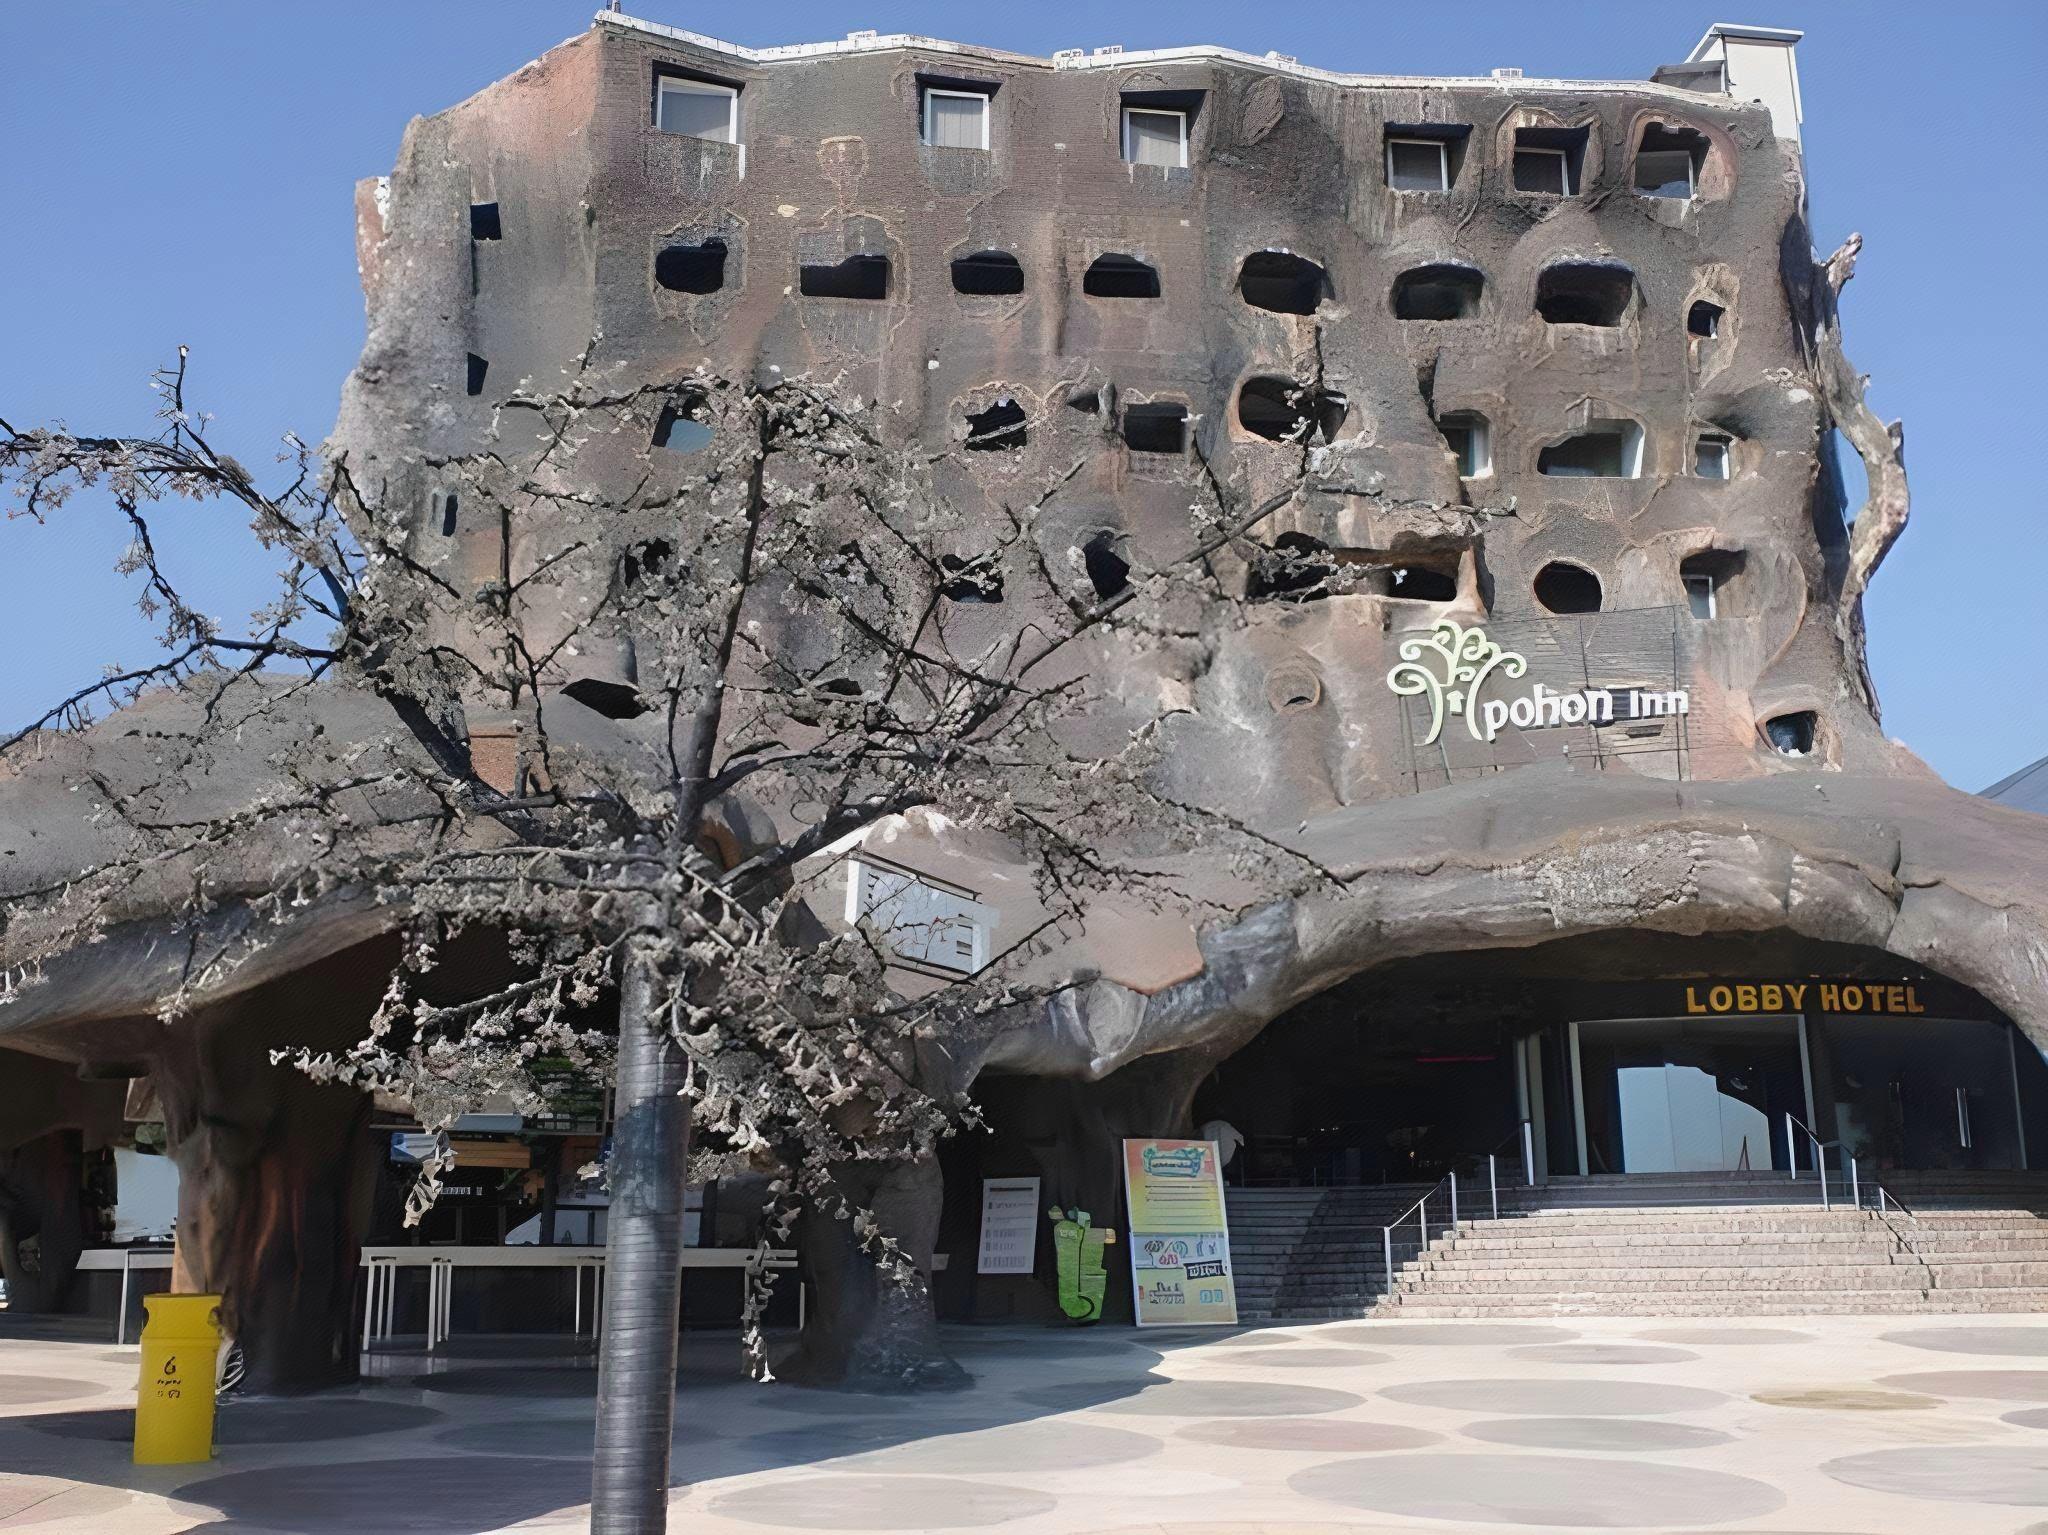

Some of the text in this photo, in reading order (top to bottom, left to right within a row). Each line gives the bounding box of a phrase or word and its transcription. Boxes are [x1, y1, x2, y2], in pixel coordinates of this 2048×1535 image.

[1483, 684, 1613, 742] pohon
[1687, 984, 1924, 1013] LOBBY HOTEL
